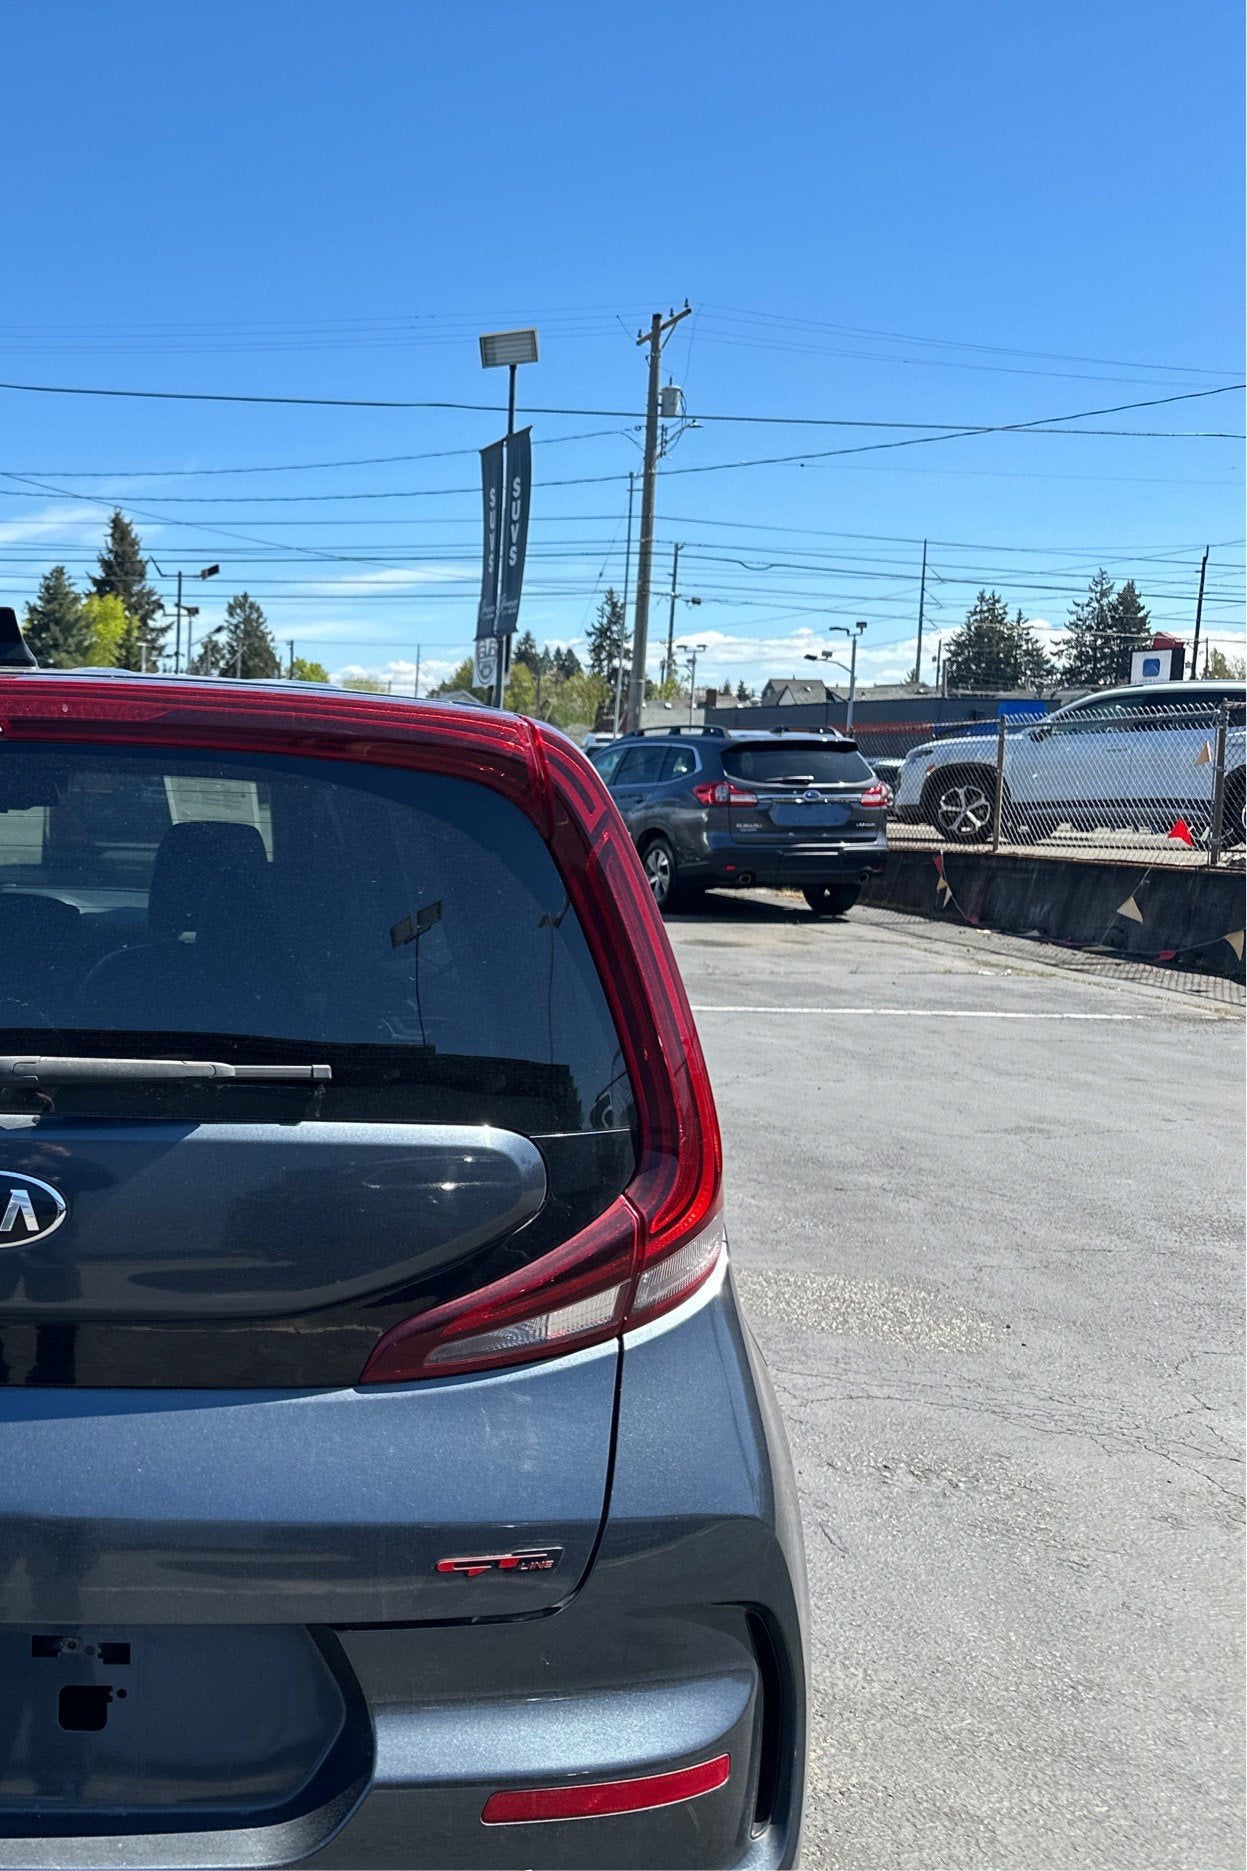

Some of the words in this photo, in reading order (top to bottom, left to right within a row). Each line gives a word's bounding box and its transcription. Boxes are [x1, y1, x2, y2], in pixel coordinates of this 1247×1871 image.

[488, 487, 496, 573] SUVS
[509, 476, 522, 567] SUVS
[520, 1560, 554, 1571] LINE
